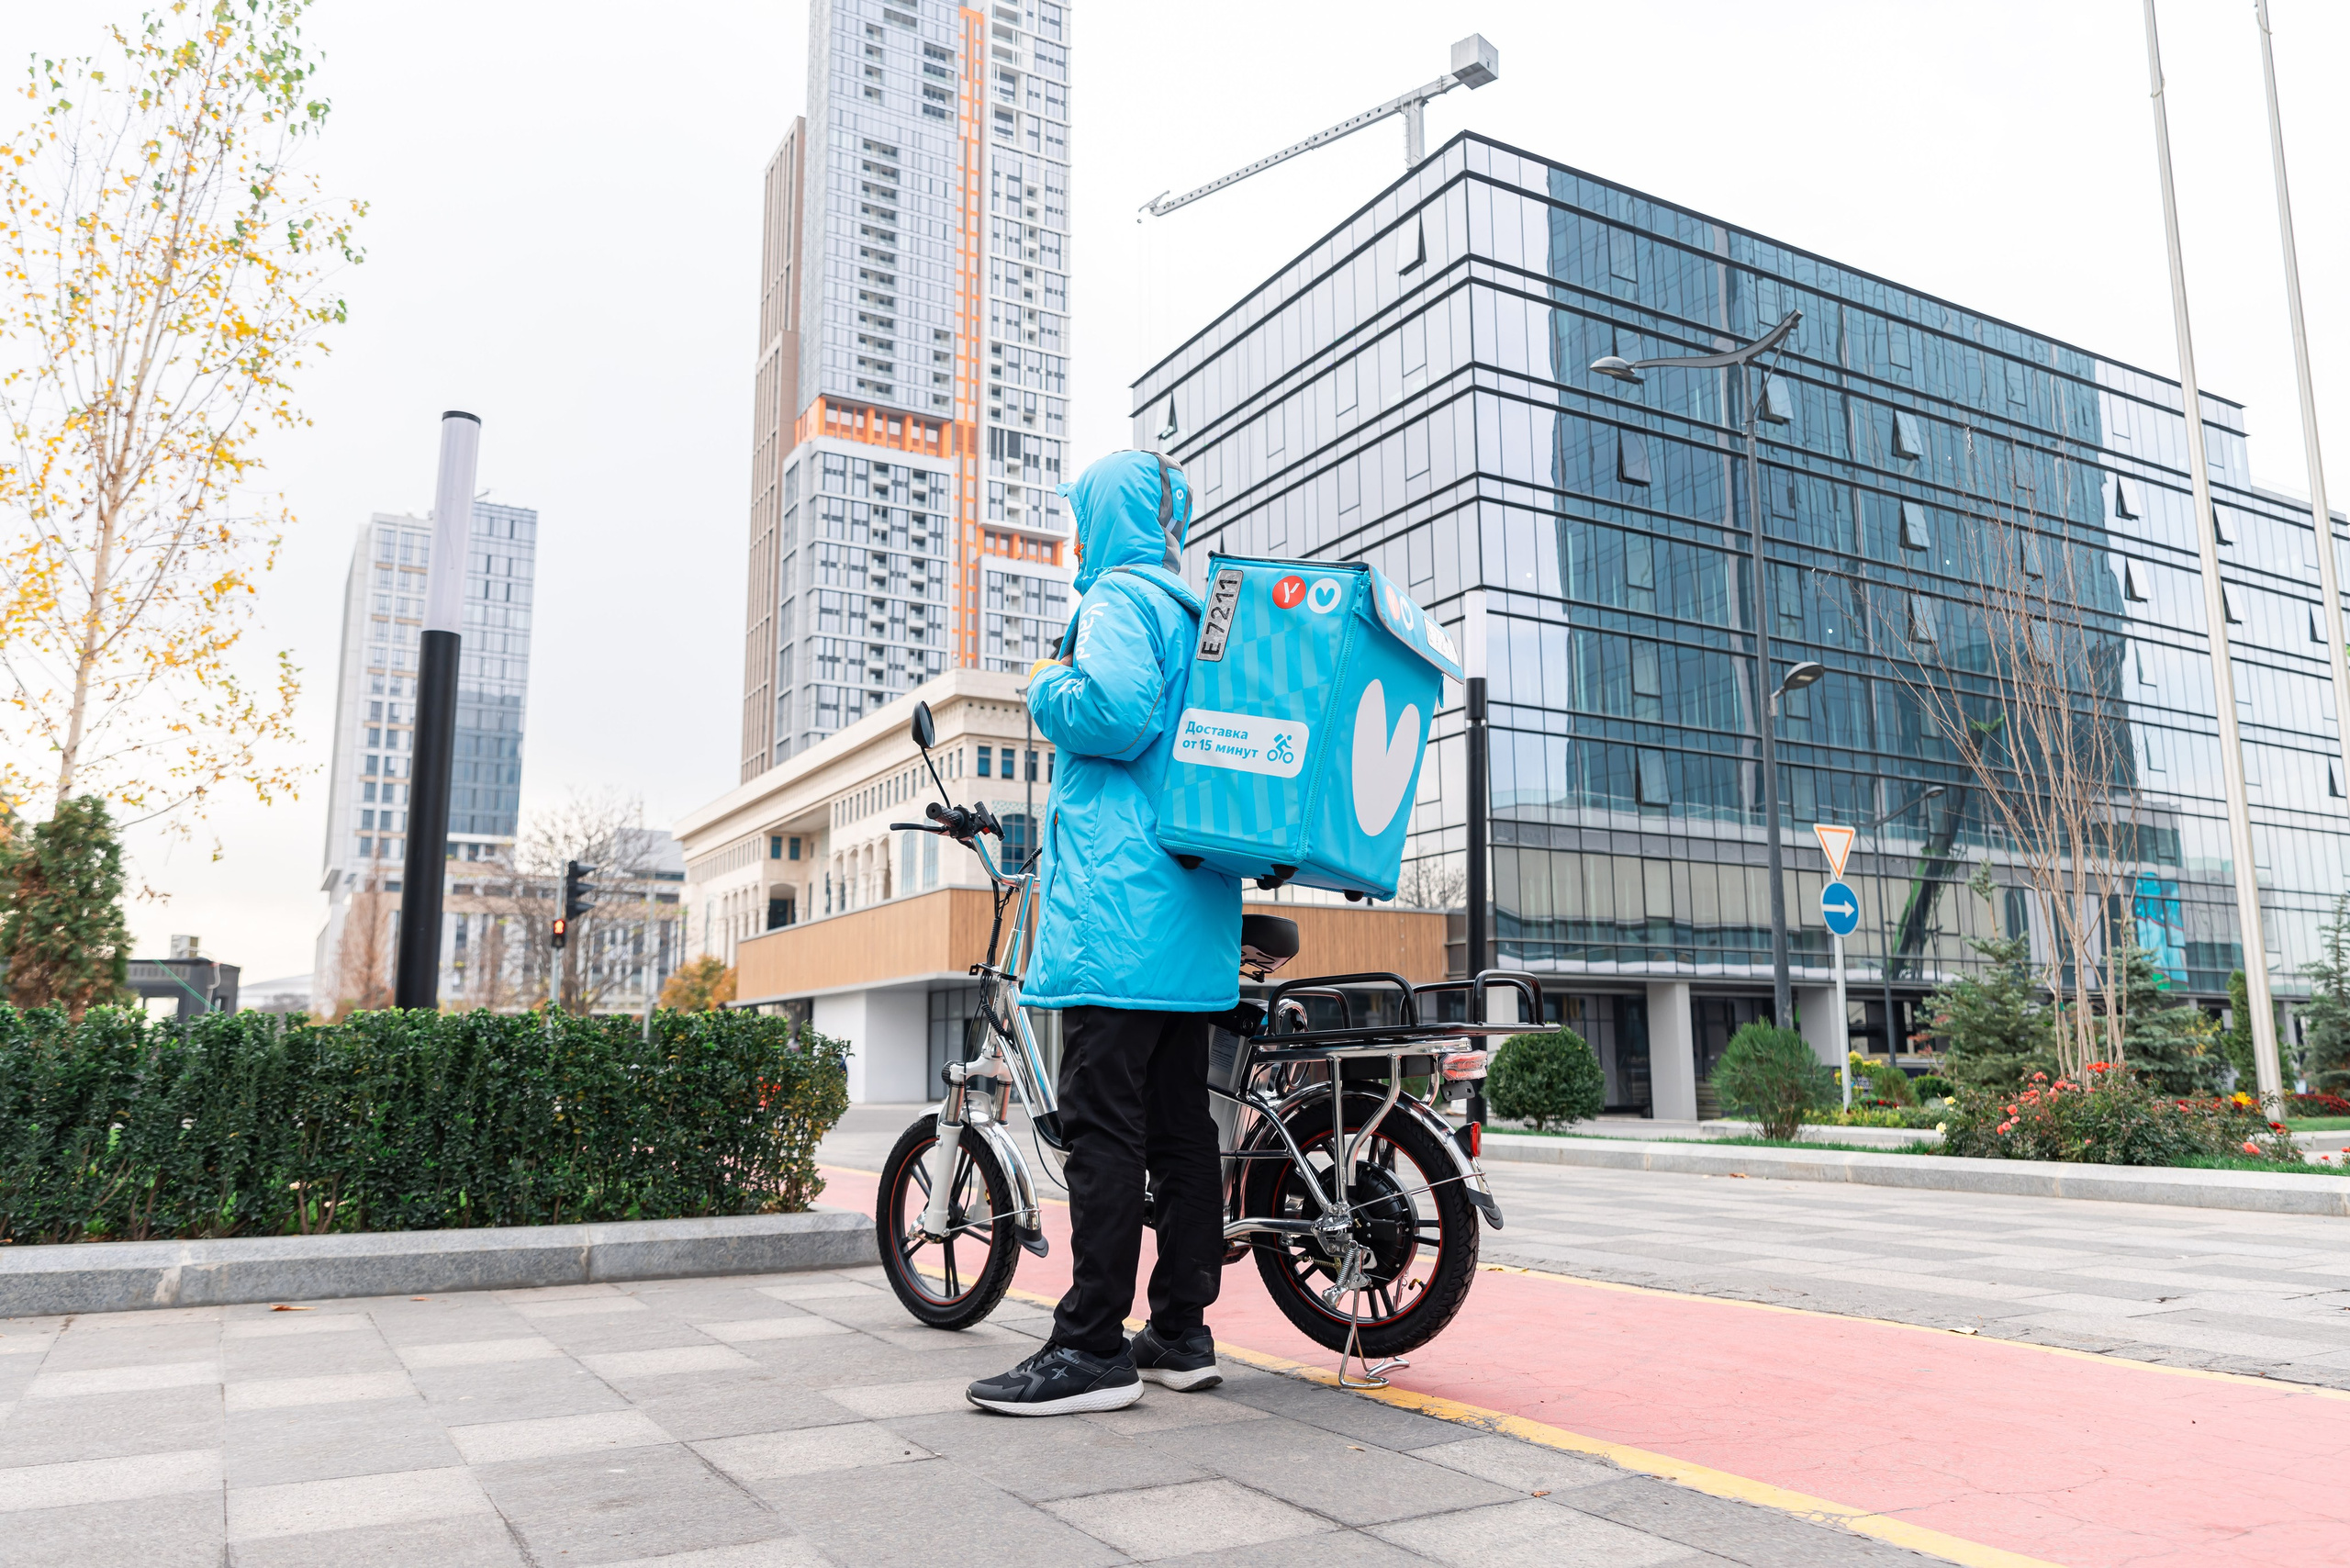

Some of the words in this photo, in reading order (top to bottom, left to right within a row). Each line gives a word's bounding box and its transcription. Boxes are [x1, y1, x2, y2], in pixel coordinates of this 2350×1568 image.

[1075, 602, 1109, 673] Yand
[1201, 579, 1237, 655] E7211
[1182, 739, 1197, 749] от
[1199, 738, 1213, 751] 15
[1215, 744, 1259, 759] минут
[1185, 721, 1248, 740] Доставка
